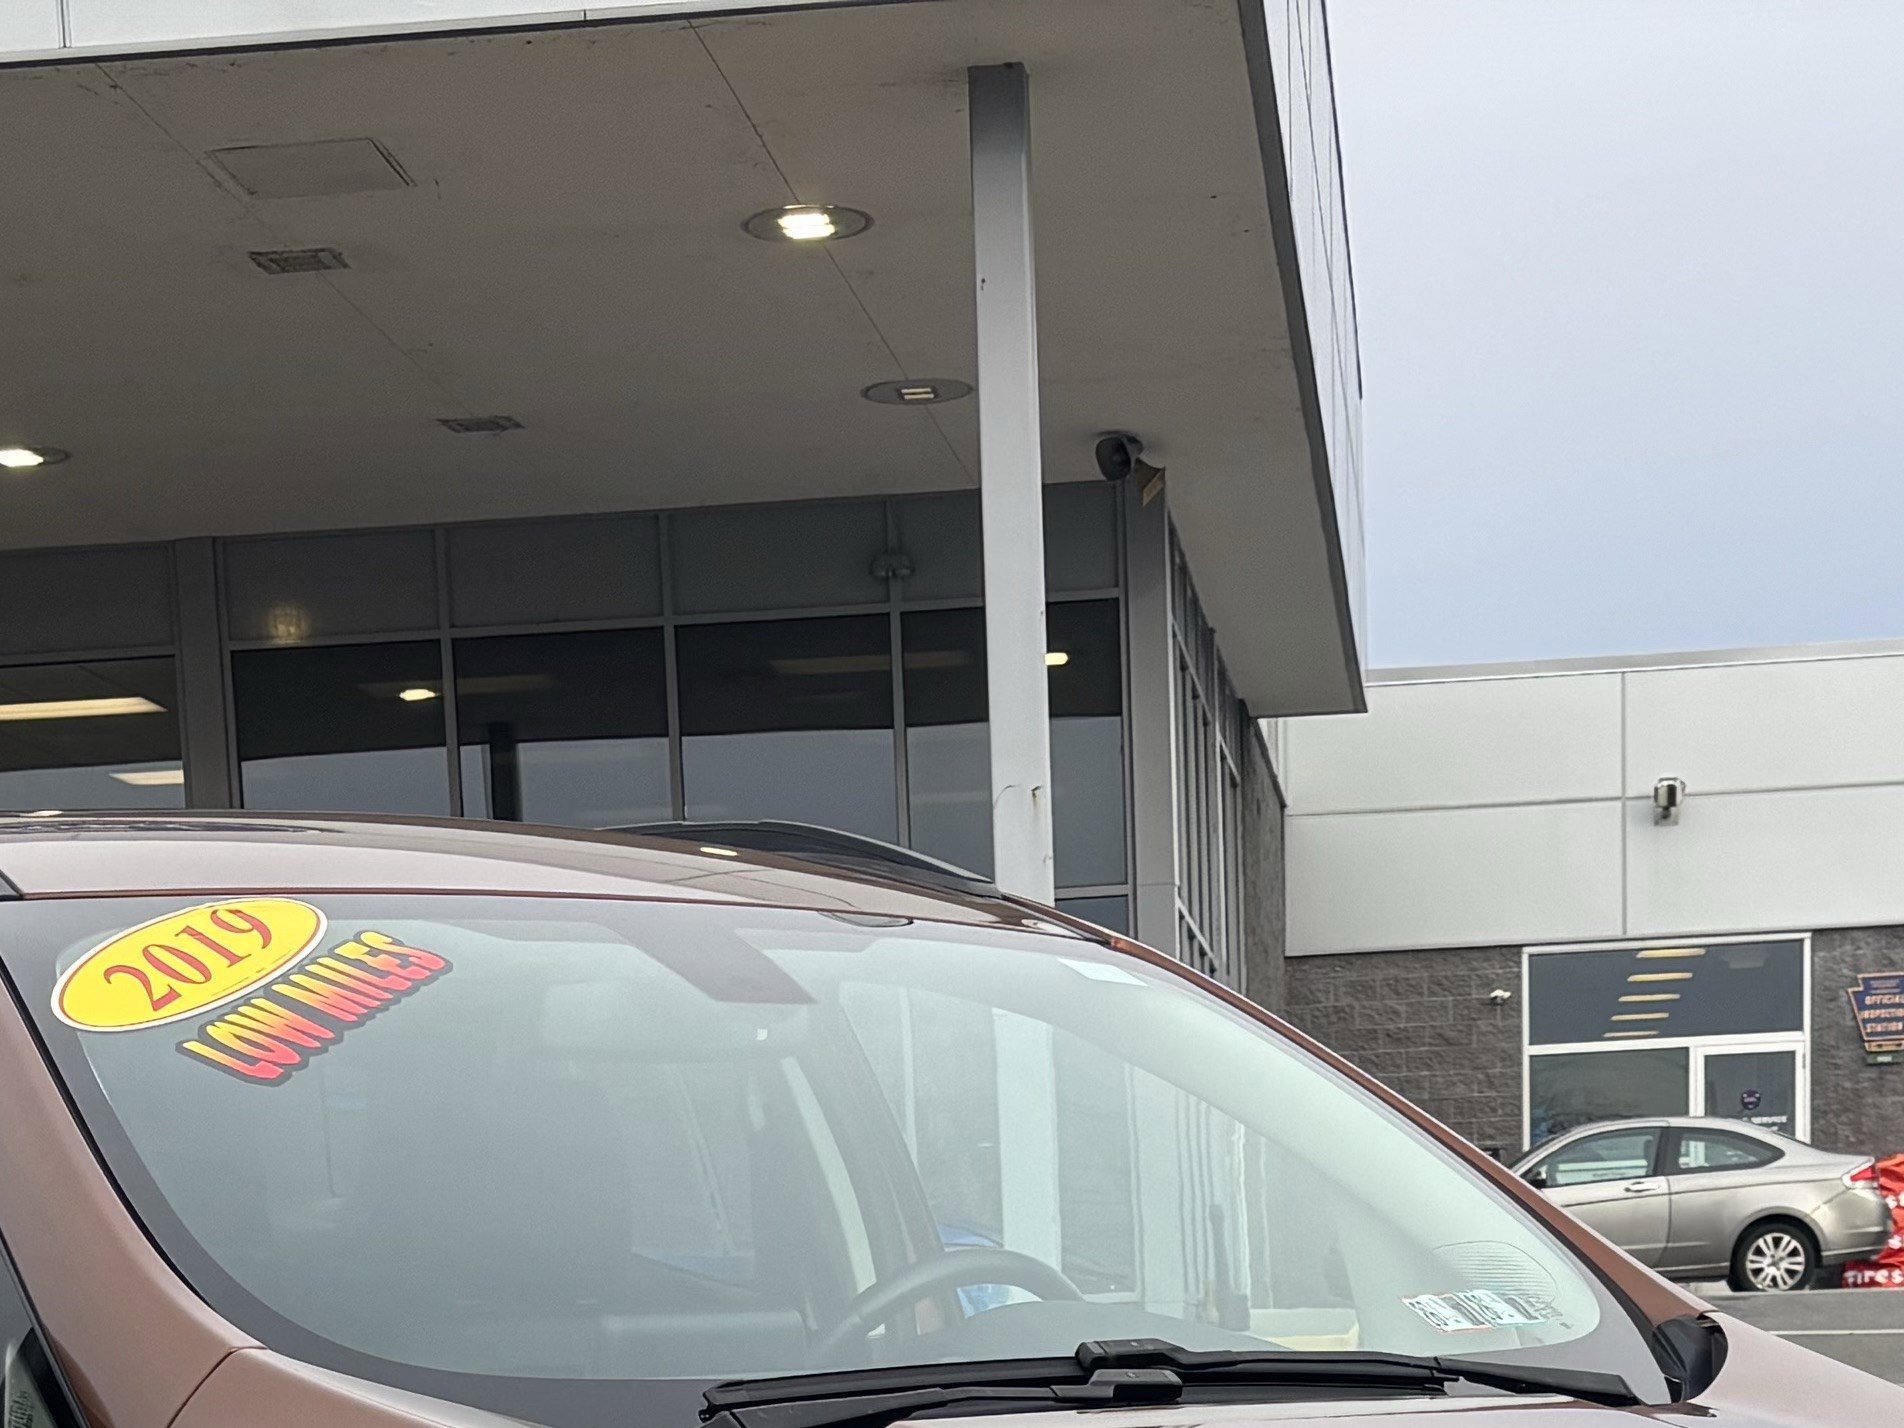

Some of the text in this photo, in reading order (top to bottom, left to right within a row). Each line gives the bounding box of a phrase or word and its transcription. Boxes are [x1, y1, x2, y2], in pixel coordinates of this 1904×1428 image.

[103, 908, 273, 1012] 2019
[181, 930, 448, 1080] LOW MILES
